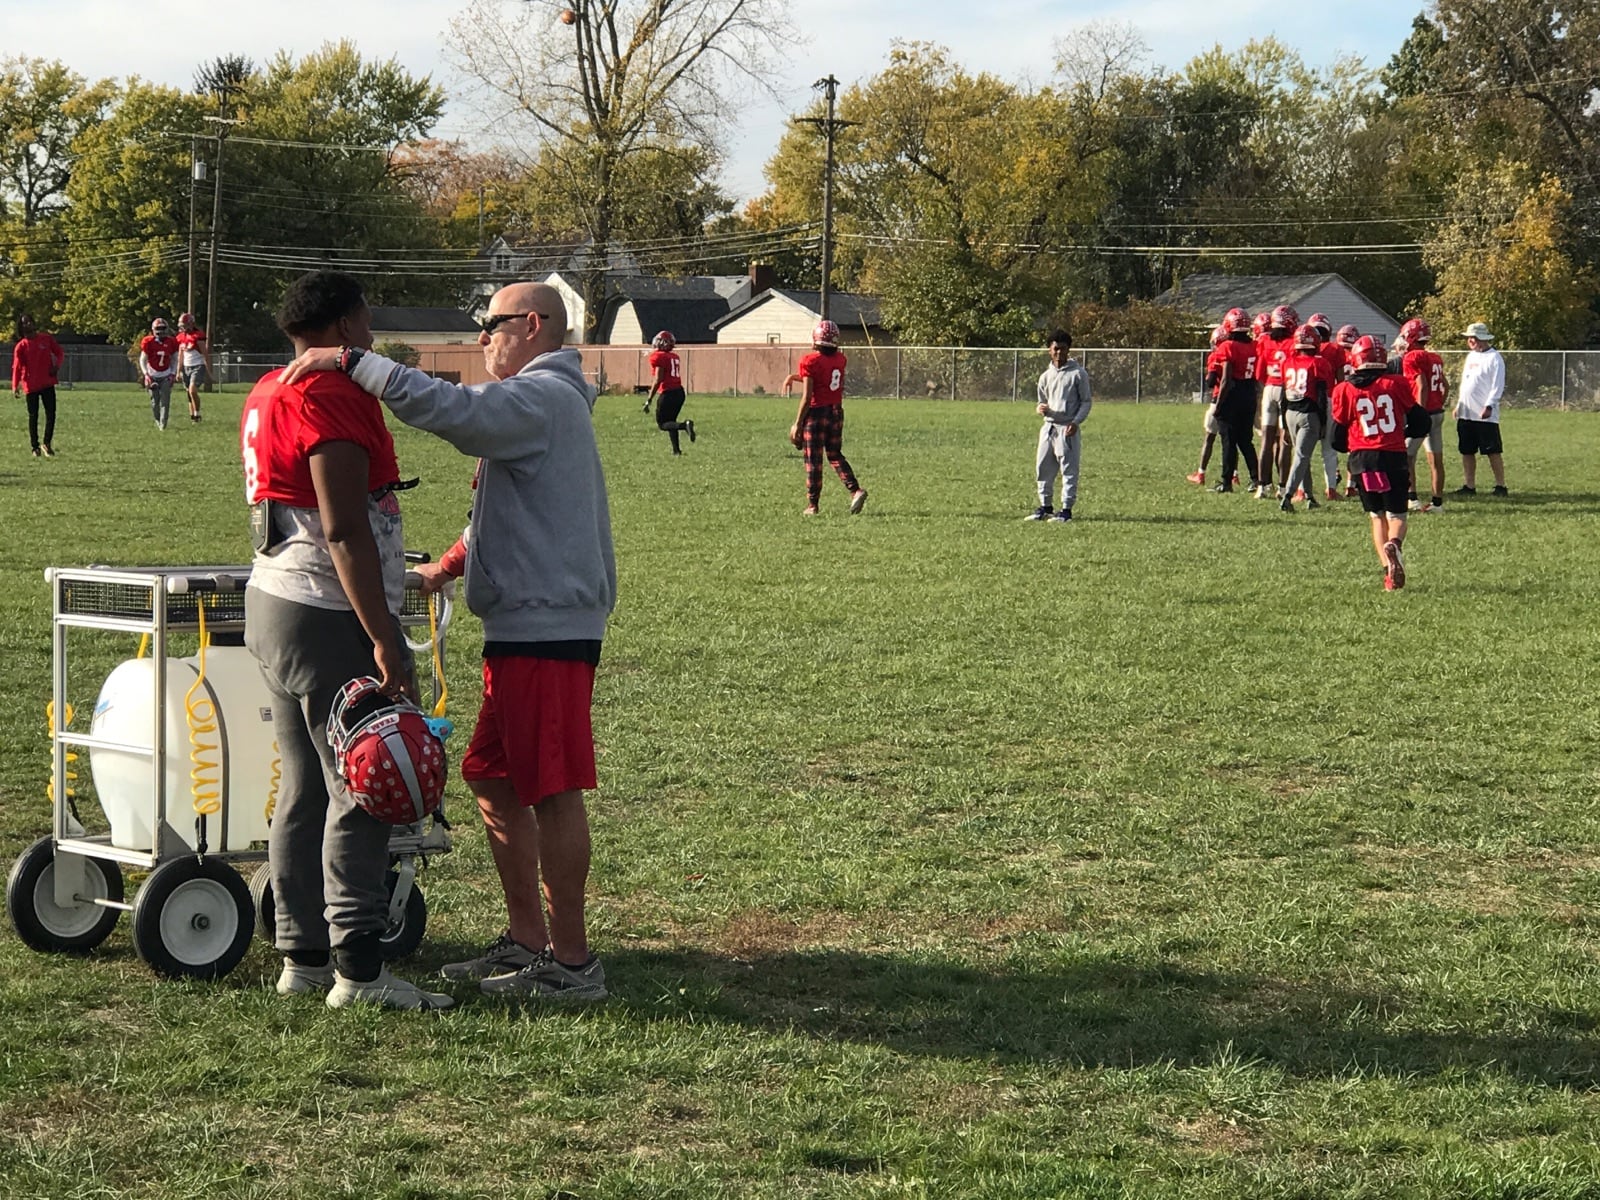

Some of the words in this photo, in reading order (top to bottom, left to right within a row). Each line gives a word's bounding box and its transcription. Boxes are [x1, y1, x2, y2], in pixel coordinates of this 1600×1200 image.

[157, 351, 165, 366] 7
[1244, 356, 1256, 379] 5
[829, 369, 841, 391] 8
[1356, 394, 1397, 437] 23
[370, 717, 395, 732] TEAM
